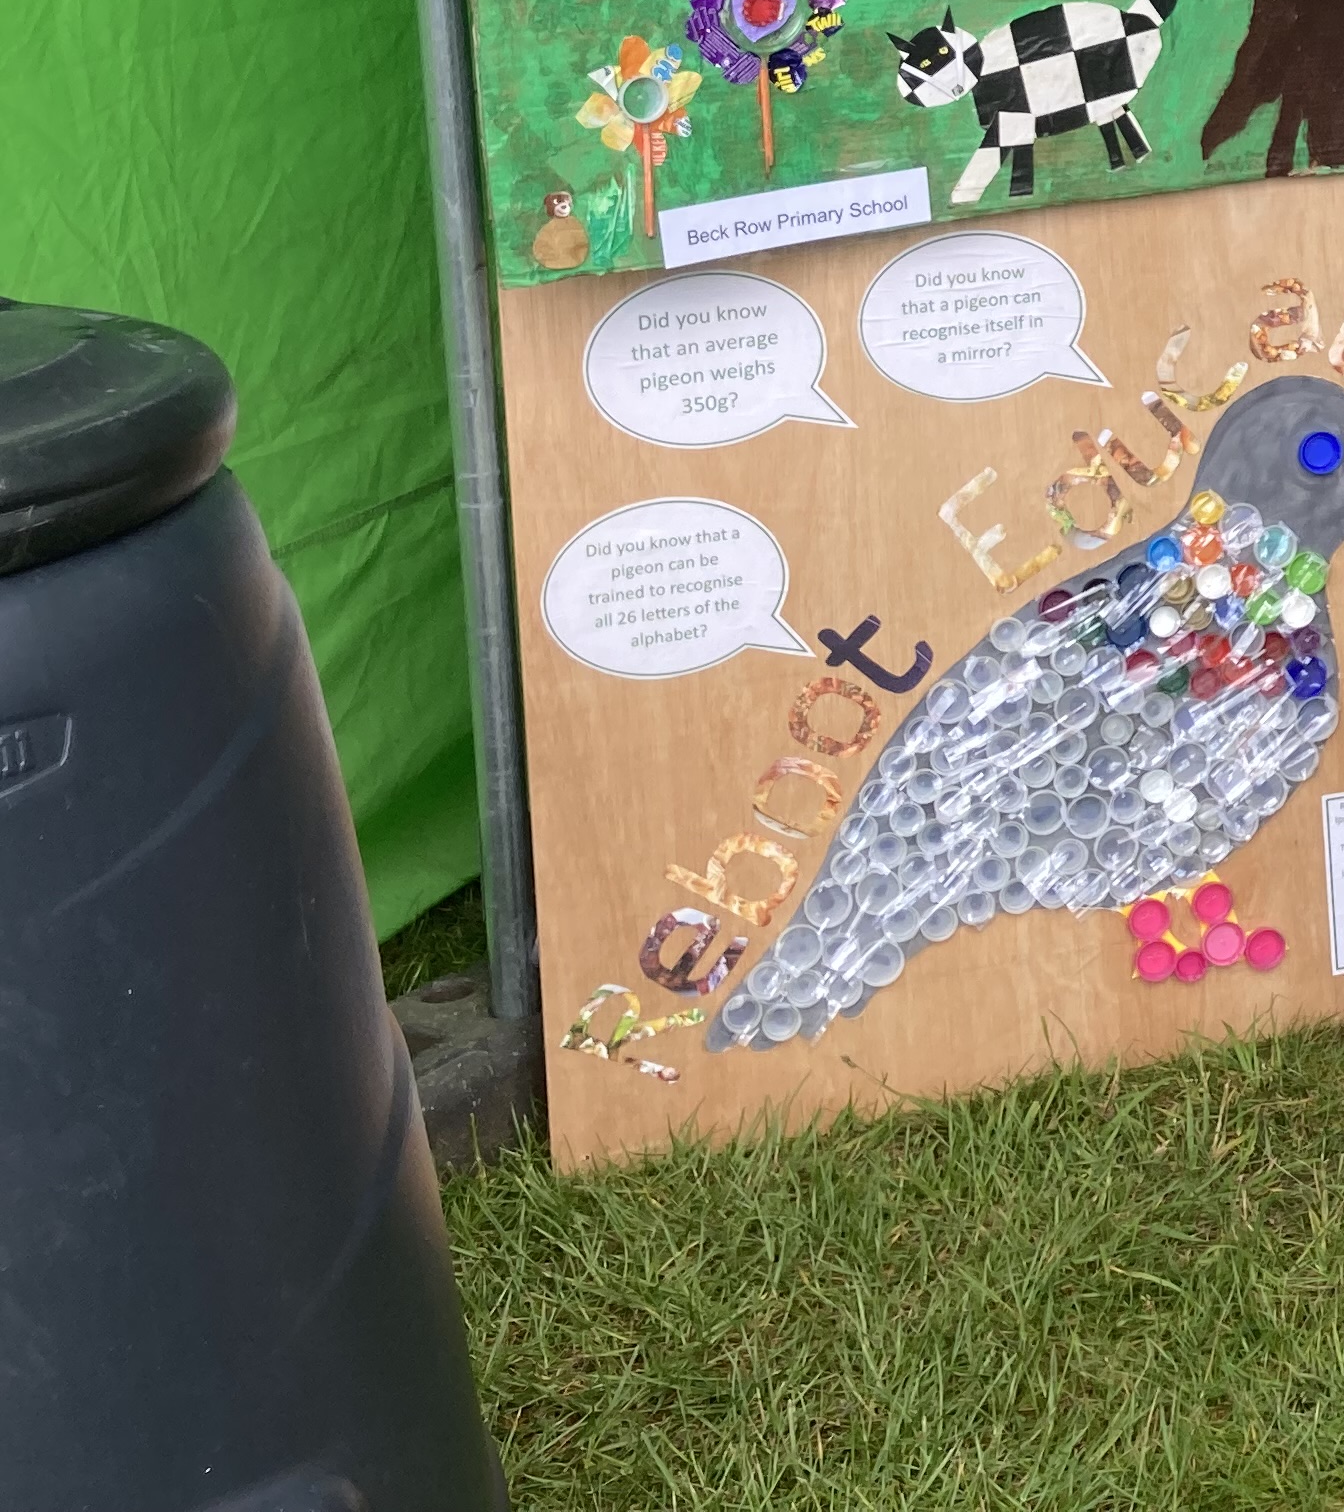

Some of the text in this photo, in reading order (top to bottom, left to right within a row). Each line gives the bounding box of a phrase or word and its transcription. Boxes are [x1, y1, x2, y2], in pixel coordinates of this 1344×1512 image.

[687, 195, 909, 246] Beck Row Primary School
[915, 267, 1025, 288] Did you know
[902, 291, 1041, 315] that a pigeon can
[638, 304, 767, 331] Did you know
[902, 315, 1044, 342] recognise itself in
[631, 332, 779, 361] that an average
[938, 342, 1012, 363] a mirror?
[640, 360, 776, 393] pigeon weighs
[682, 392, 738, 414] 350g?
[586, 528, 740, 557] Did you know that a
[611, 553, 719, 581] pigeon can be
[588, 574, 743, 605] trained to recognise
[594, 598, 740, 629] all 26 letters of the
[630, 624, 709, 648] alphabet?
